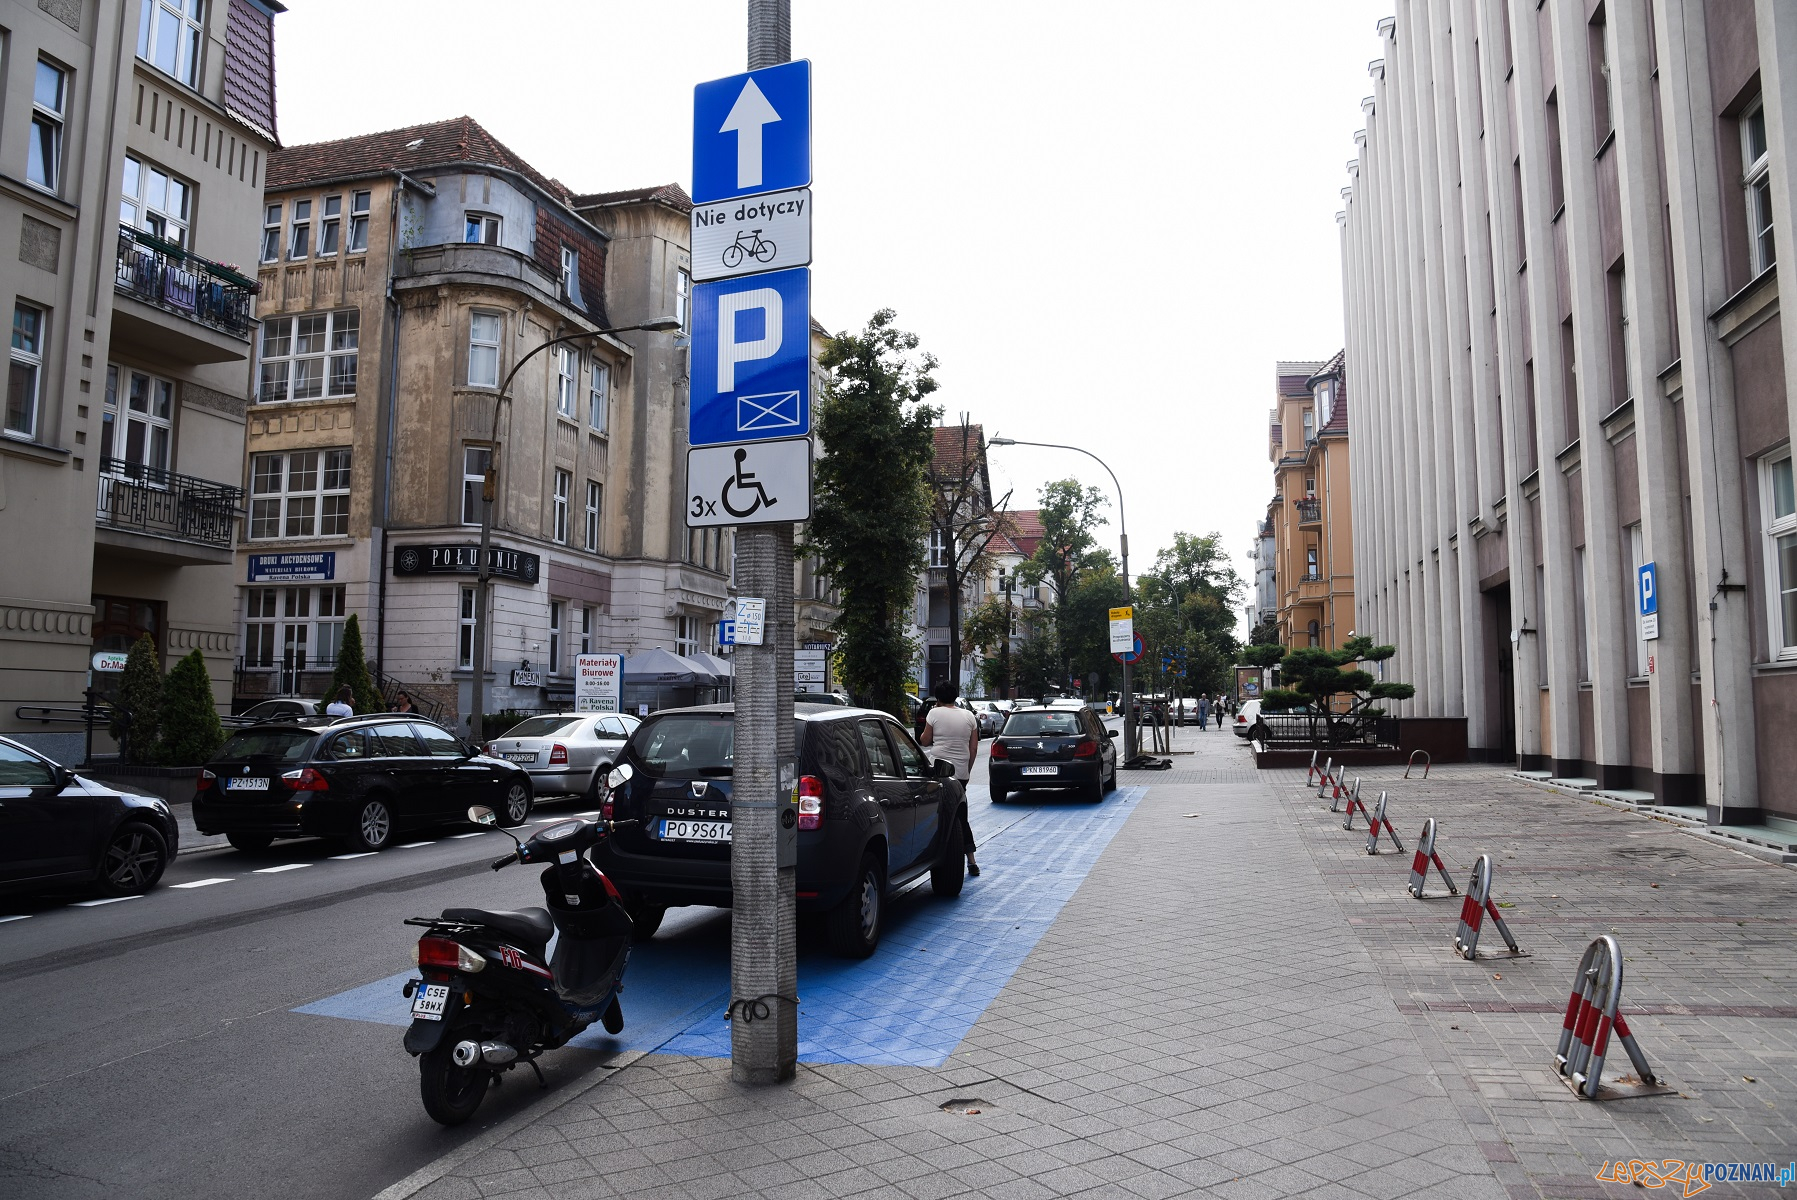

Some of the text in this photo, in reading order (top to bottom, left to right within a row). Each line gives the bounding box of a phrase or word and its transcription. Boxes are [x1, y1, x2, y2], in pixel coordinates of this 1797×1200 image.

[695, 199, 805, 228] Nie dotyczy
[717, 287, 783, 394] P
[690, 495, 717, 518] 3x
[259, 554, 324, 565] DRUKI AKCYDENSOWE
[432, 548, 518, 570] POŁUNIE
[1642, 570, 1653, 611] P
[804, 643, 831, 651] NOTARIUSZ
[102, 660, 124, 669] Dr.Ma
[579, 658, 618, 668] Materiały
[514, 671, 540, 686] MANEKIN
[582, 668, 614, 677] Biurowe
[232, 779, 268, 787] PZ 1513N
[667, 808, 728, 817] DUSTER
[667, 822, 688, 837] PO
[499, 945, 523, 970] F16
[427, 988, 446, 998] CSE
[420, 1000, 443, 1012] 58WX
